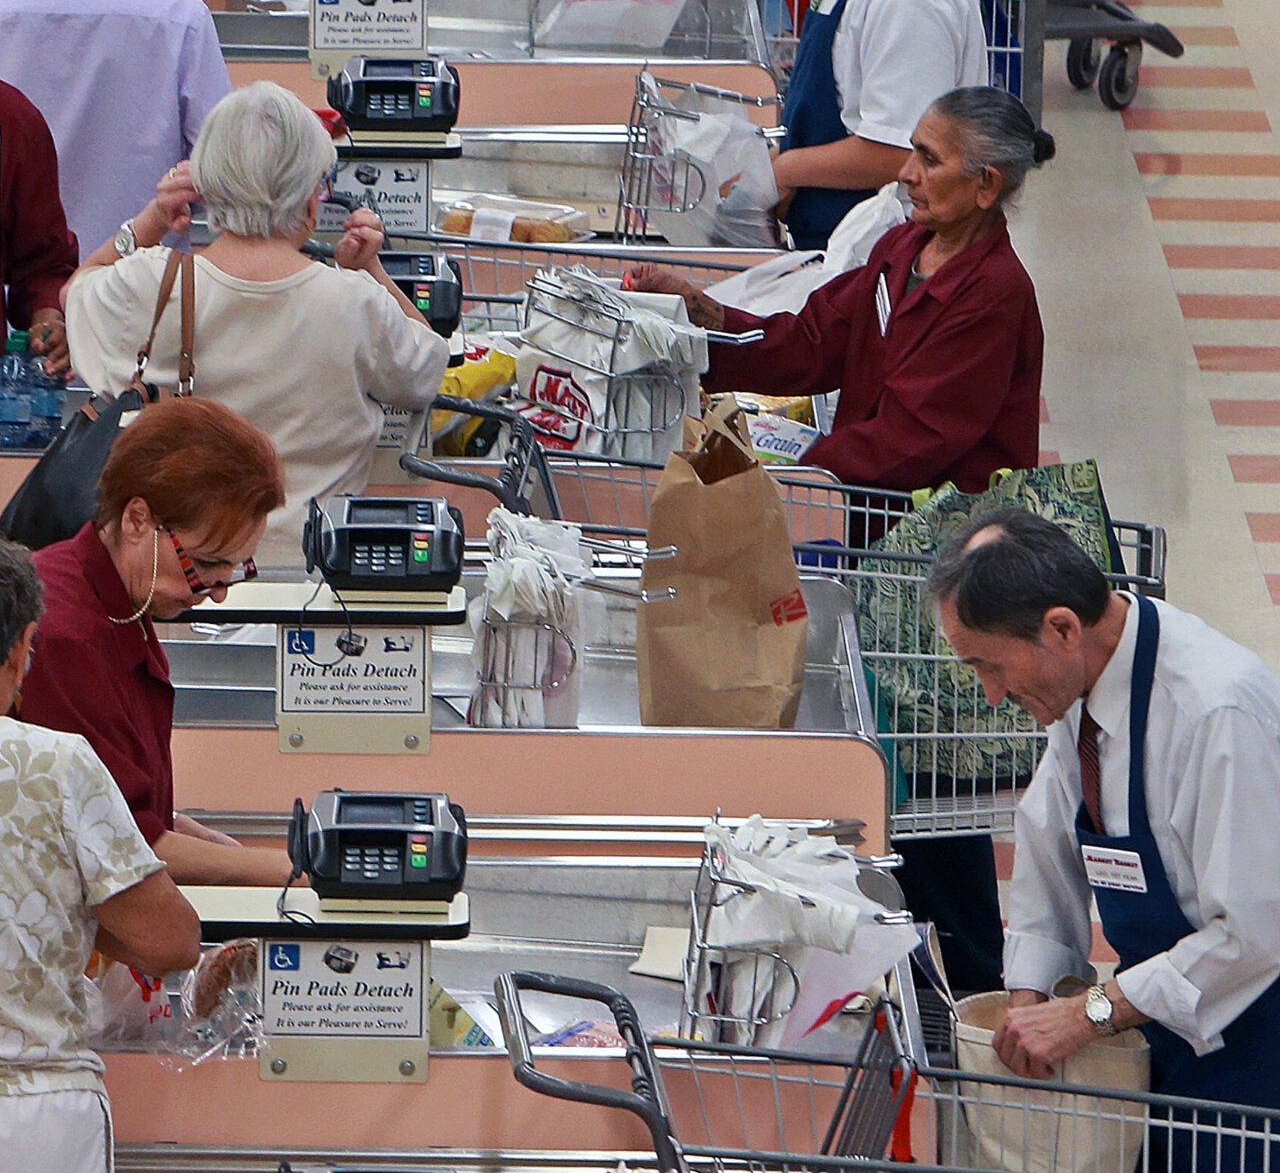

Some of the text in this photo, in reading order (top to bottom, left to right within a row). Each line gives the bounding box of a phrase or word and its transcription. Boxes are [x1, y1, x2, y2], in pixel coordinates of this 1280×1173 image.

[320, 11, 418, 23] Pin Pads Detach
[378, 191, 421, 204] Detach
[756, 432, 802, 455] Grain
[290, 663, 417, 678] Pin Pads Detach
[299, 682, 408, 693] Please ask for assistance
[314, 698, 329, 706] our
[332, 697, 370, 706] Pleasure
[383, 697, 413, 707] Serve!
[272, 980, 414, 998] Pin Pads Detach
[282, 1002, 404, 1014] Please ask for assistance
[297, 1019, 316, 1028] our
[319, 1018, 362, 1028] Pleasure
[376, 1019, 408, 1030] Serve!
